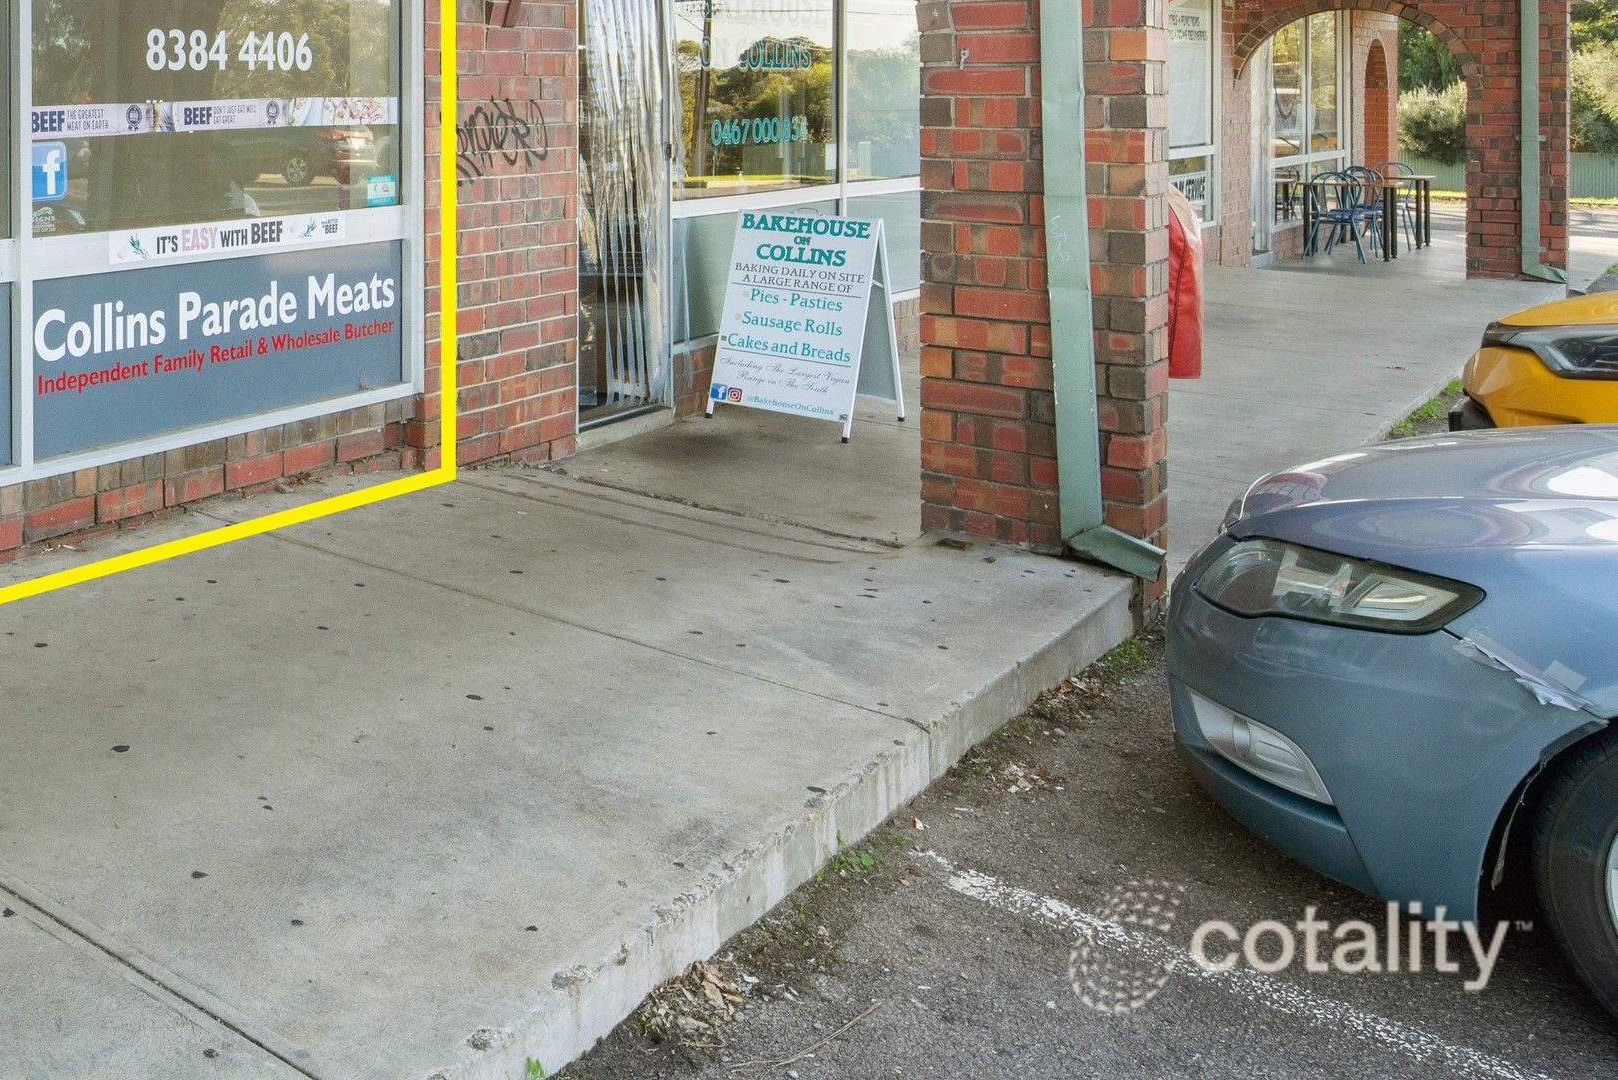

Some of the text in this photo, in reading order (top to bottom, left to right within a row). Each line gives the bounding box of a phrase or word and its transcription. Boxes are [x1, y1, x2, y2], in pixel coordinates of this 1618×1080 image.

[146, 28, 313, 71] 8384 4406
[738, 38, 812, 71] COLLINS
[32, 108, 104, 133] BEEF THE GREATEST
[67, 119, 109, 131] MEAT ON EARTH
[184, 107, 212, 125] BEEF
[213, 106, 226, 115] DON'T
[226, 105, 237, 114] JUST
[237, 105, 245, 113] EAT
[213, 116, 221, 124] EAT
[710, 118, 750, 147] 0467
[752, 117, 780, 144] 000
[1186, 177, 1205, 201] SERVICE
[156, 220, 283, 254] IT'S EASY WITH BEEF
[741, 213, 871, 239] BAKEHOUSE
[793, 236, 811, 246] ON
[756, 243, 846, 267] COLLINS
[735, 262, 865, 284] BAKING DAILY ON SITE
[742, 274, 853, 294] A LARGE RANGE OF
[750, 288, 779, 304] Pies
[790, 293, 843, 312] Pasties
[34, 272, 395, 361] Collins Parade Meats
[742, 311, 843, 337] Sausage Rolls
[38, 319, 395, 395] Independent Family Retail & Wholesale Butcher
[728, 333, 851, 363] Cakes and Breads
[720, 357, 851, 385] Including The Largest Vegan
[736, 370, 766, 384] Range
[779, 379, 798, 389] The
[802, 383, 828, 394] South
